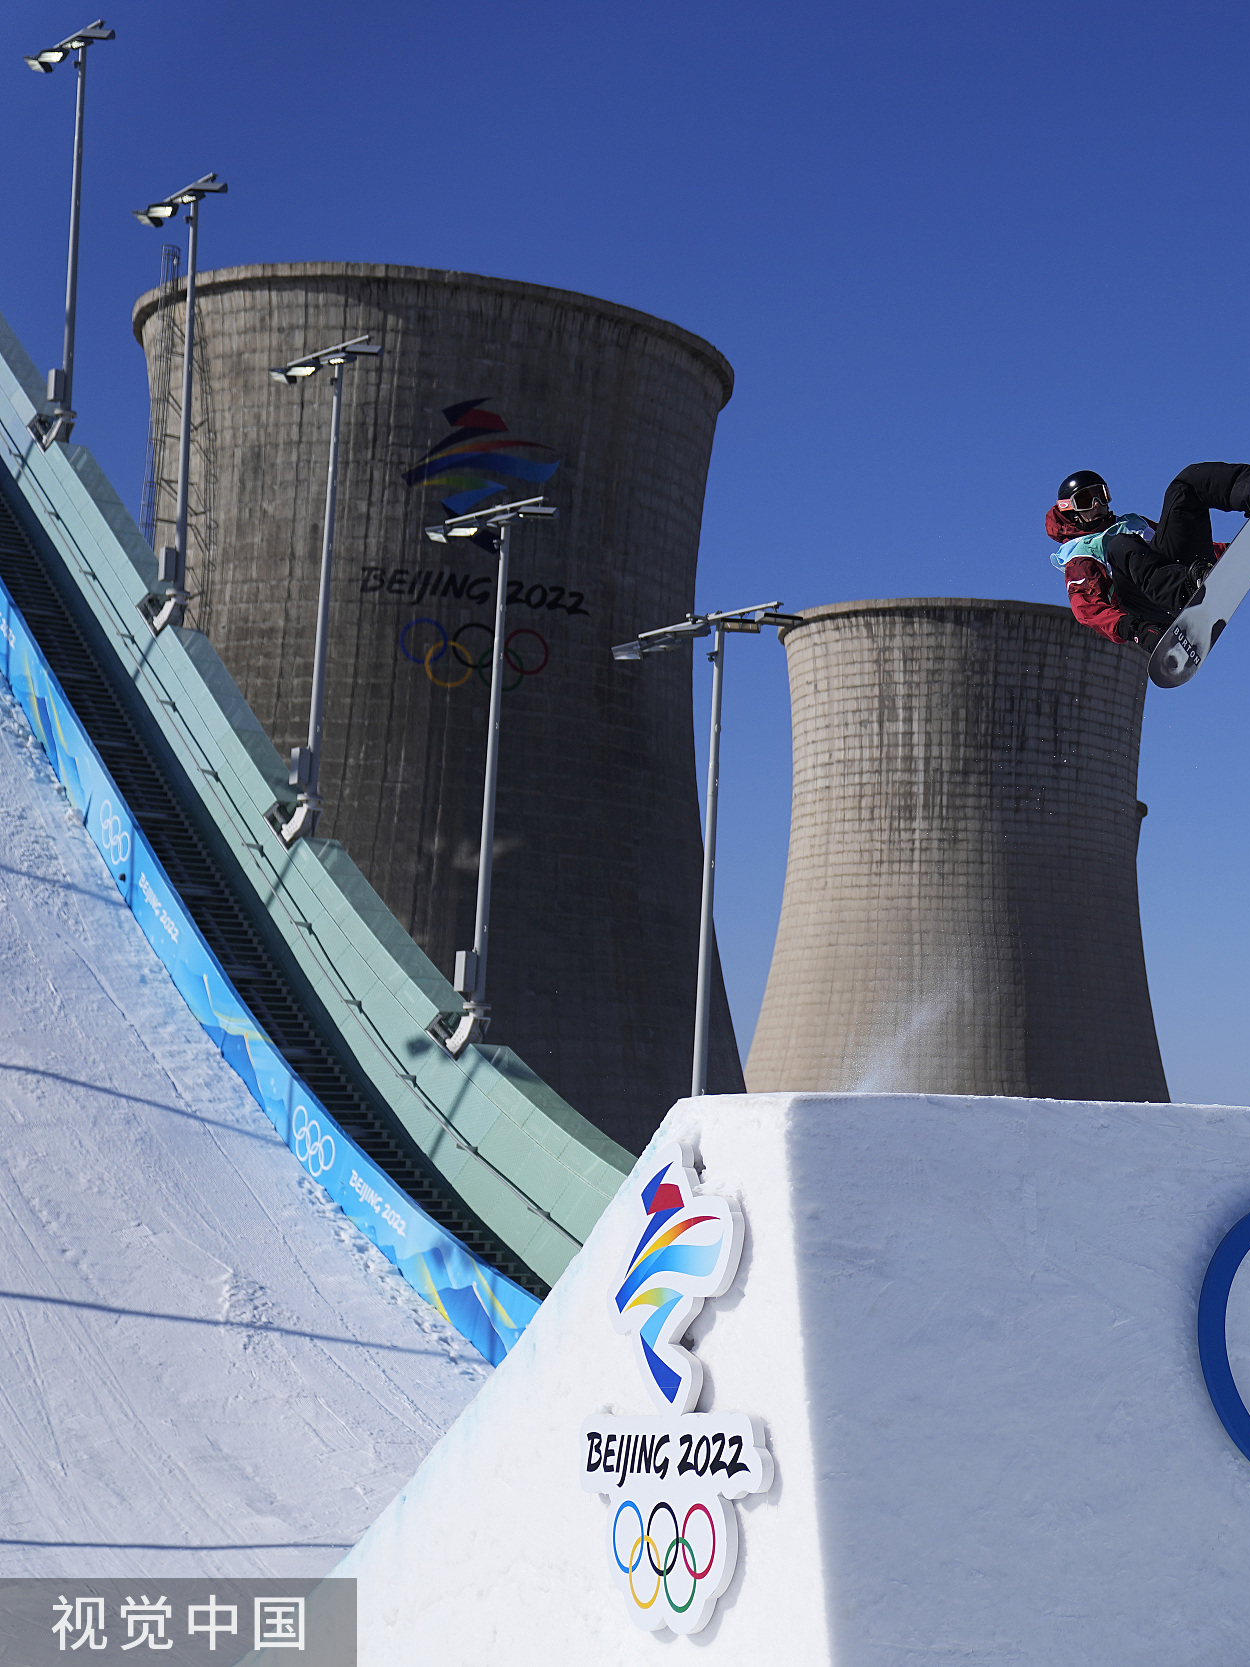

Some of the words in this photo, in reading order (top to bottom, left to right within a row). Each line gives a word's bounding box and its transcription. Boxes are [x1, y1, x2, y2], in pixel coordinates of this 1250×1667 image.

[361, 566, 492, 605] BEIJING
[506, 580, 591, 618] 2022
[1173, 626, 1200, 665] BURTON
[139, 871, 162, 917] BEIJING
[160, 909, 179, 944] 2022
[349, 1169, 383, 1214] BEIJING
[381, 1203, 406, 1239] 2022
[586, 1431, 670, 1488] BEIJING
[677, 1432, 751, 1479] 2022
